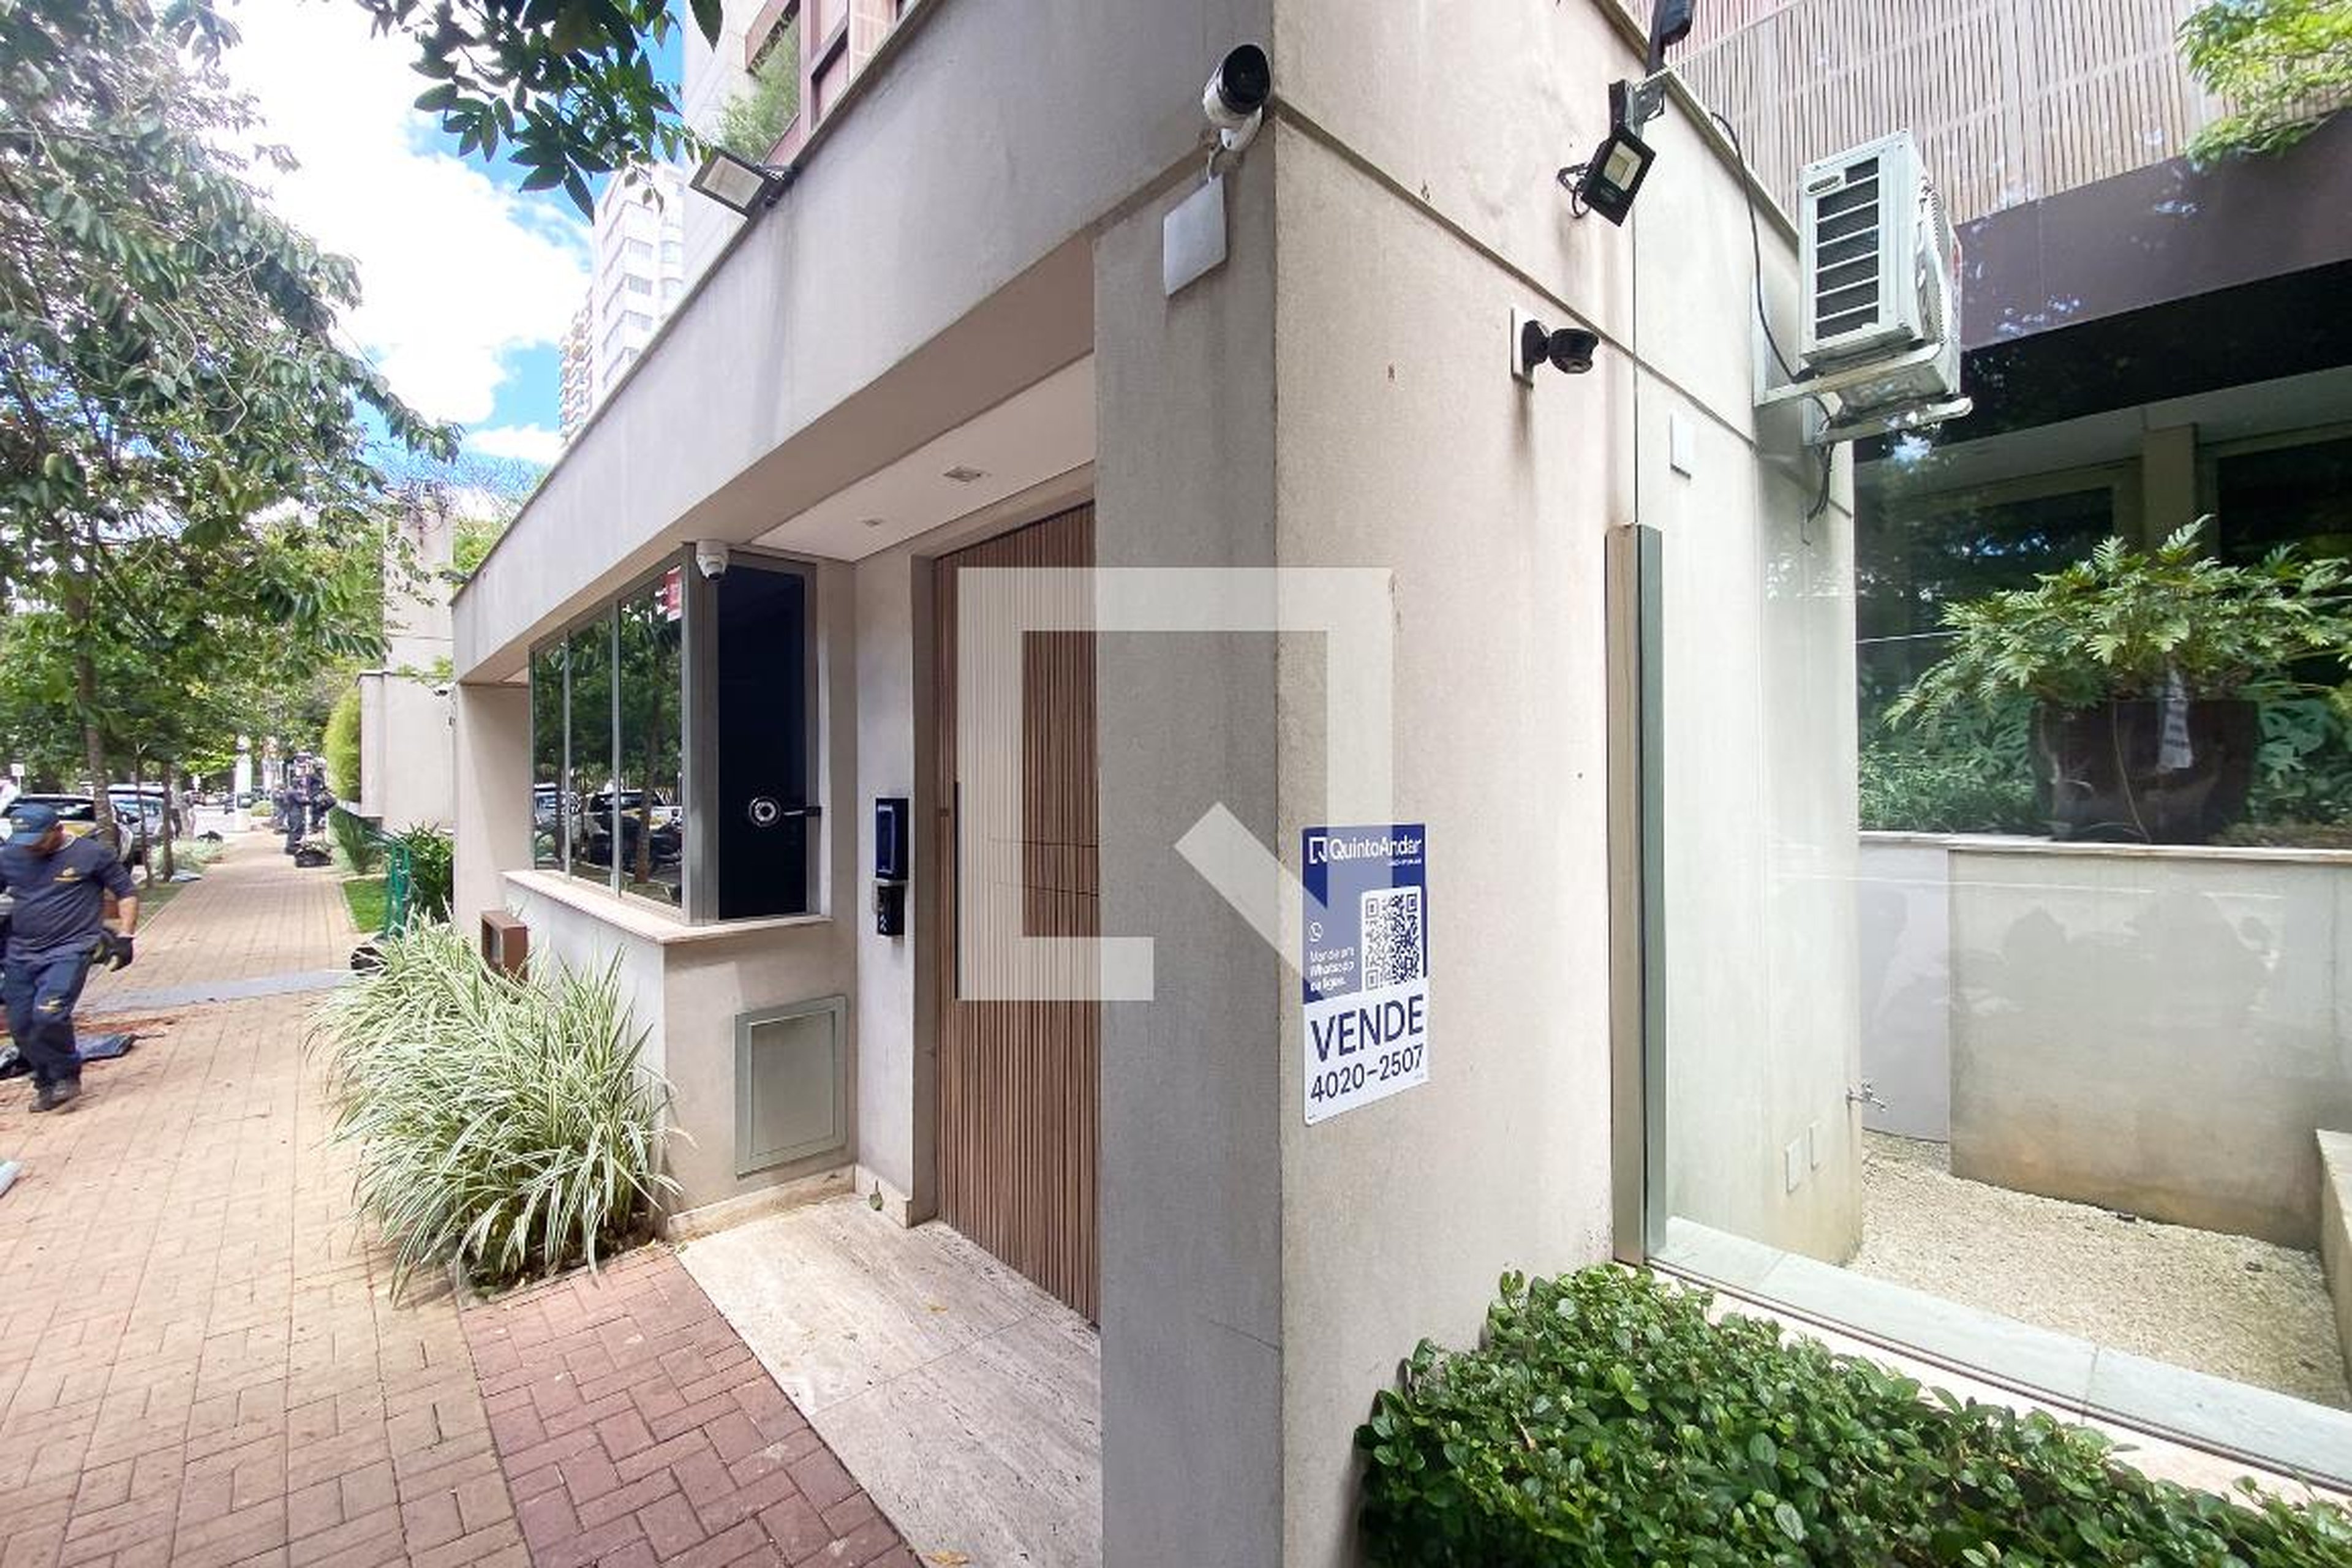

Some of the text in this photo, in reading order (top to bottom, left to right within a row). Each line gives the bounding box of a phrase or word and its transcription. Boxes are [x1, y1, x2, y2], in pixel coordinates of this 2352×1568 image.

[1329, 835, 1422, 860] QuintoAndar
[1311, 994, 1423, 1062] VENDE
[1311, 1043, 1423, 1102] 4020-2507
